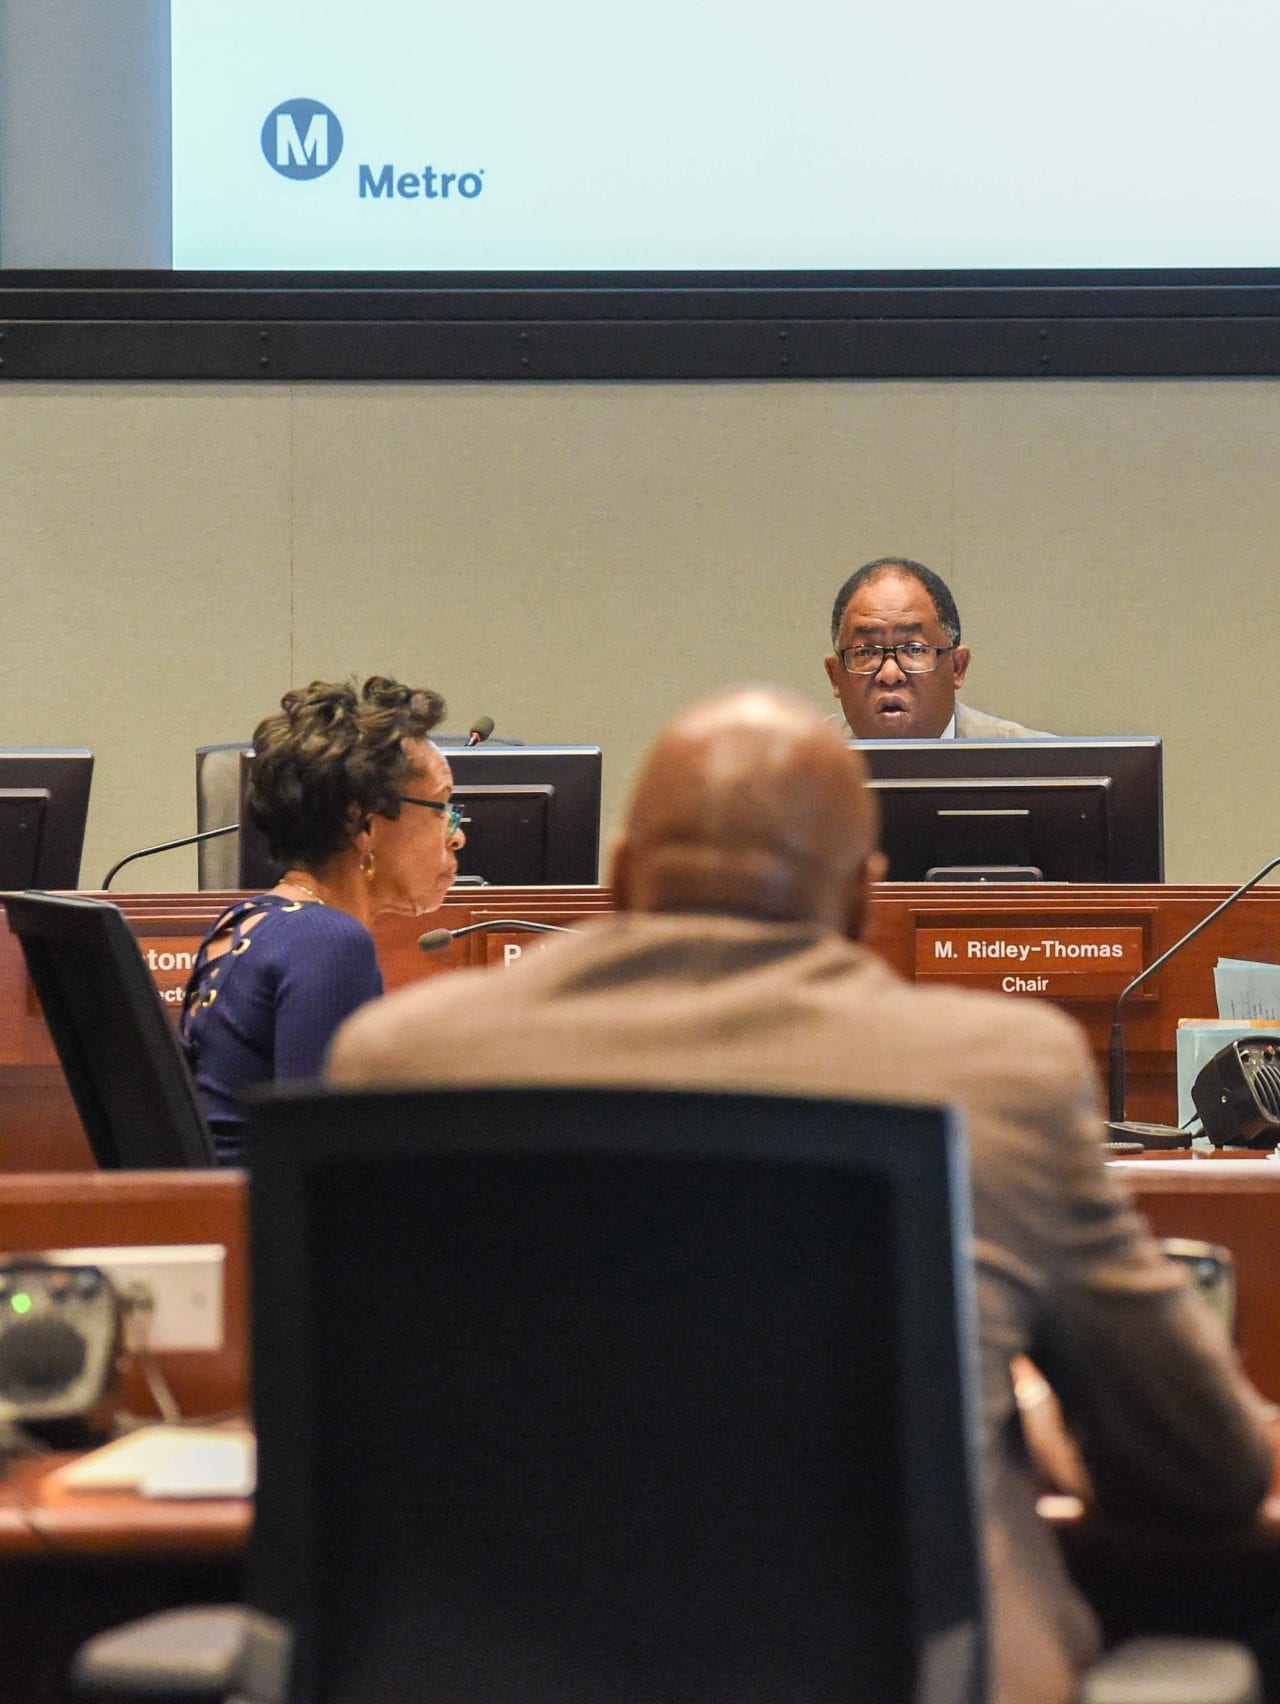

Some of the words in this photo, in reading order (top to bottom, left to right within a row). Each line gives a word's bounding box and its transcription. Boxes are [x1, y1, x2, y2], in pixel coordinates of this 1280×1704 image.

[275, 113, 328, 166] M
[358, 164, 484, 199] Metro
[934, 941, 958, 958] M.
[967, 941, 1124, 961] Ridley-Thomas
[1002, 976, 1049, 993] Chair
